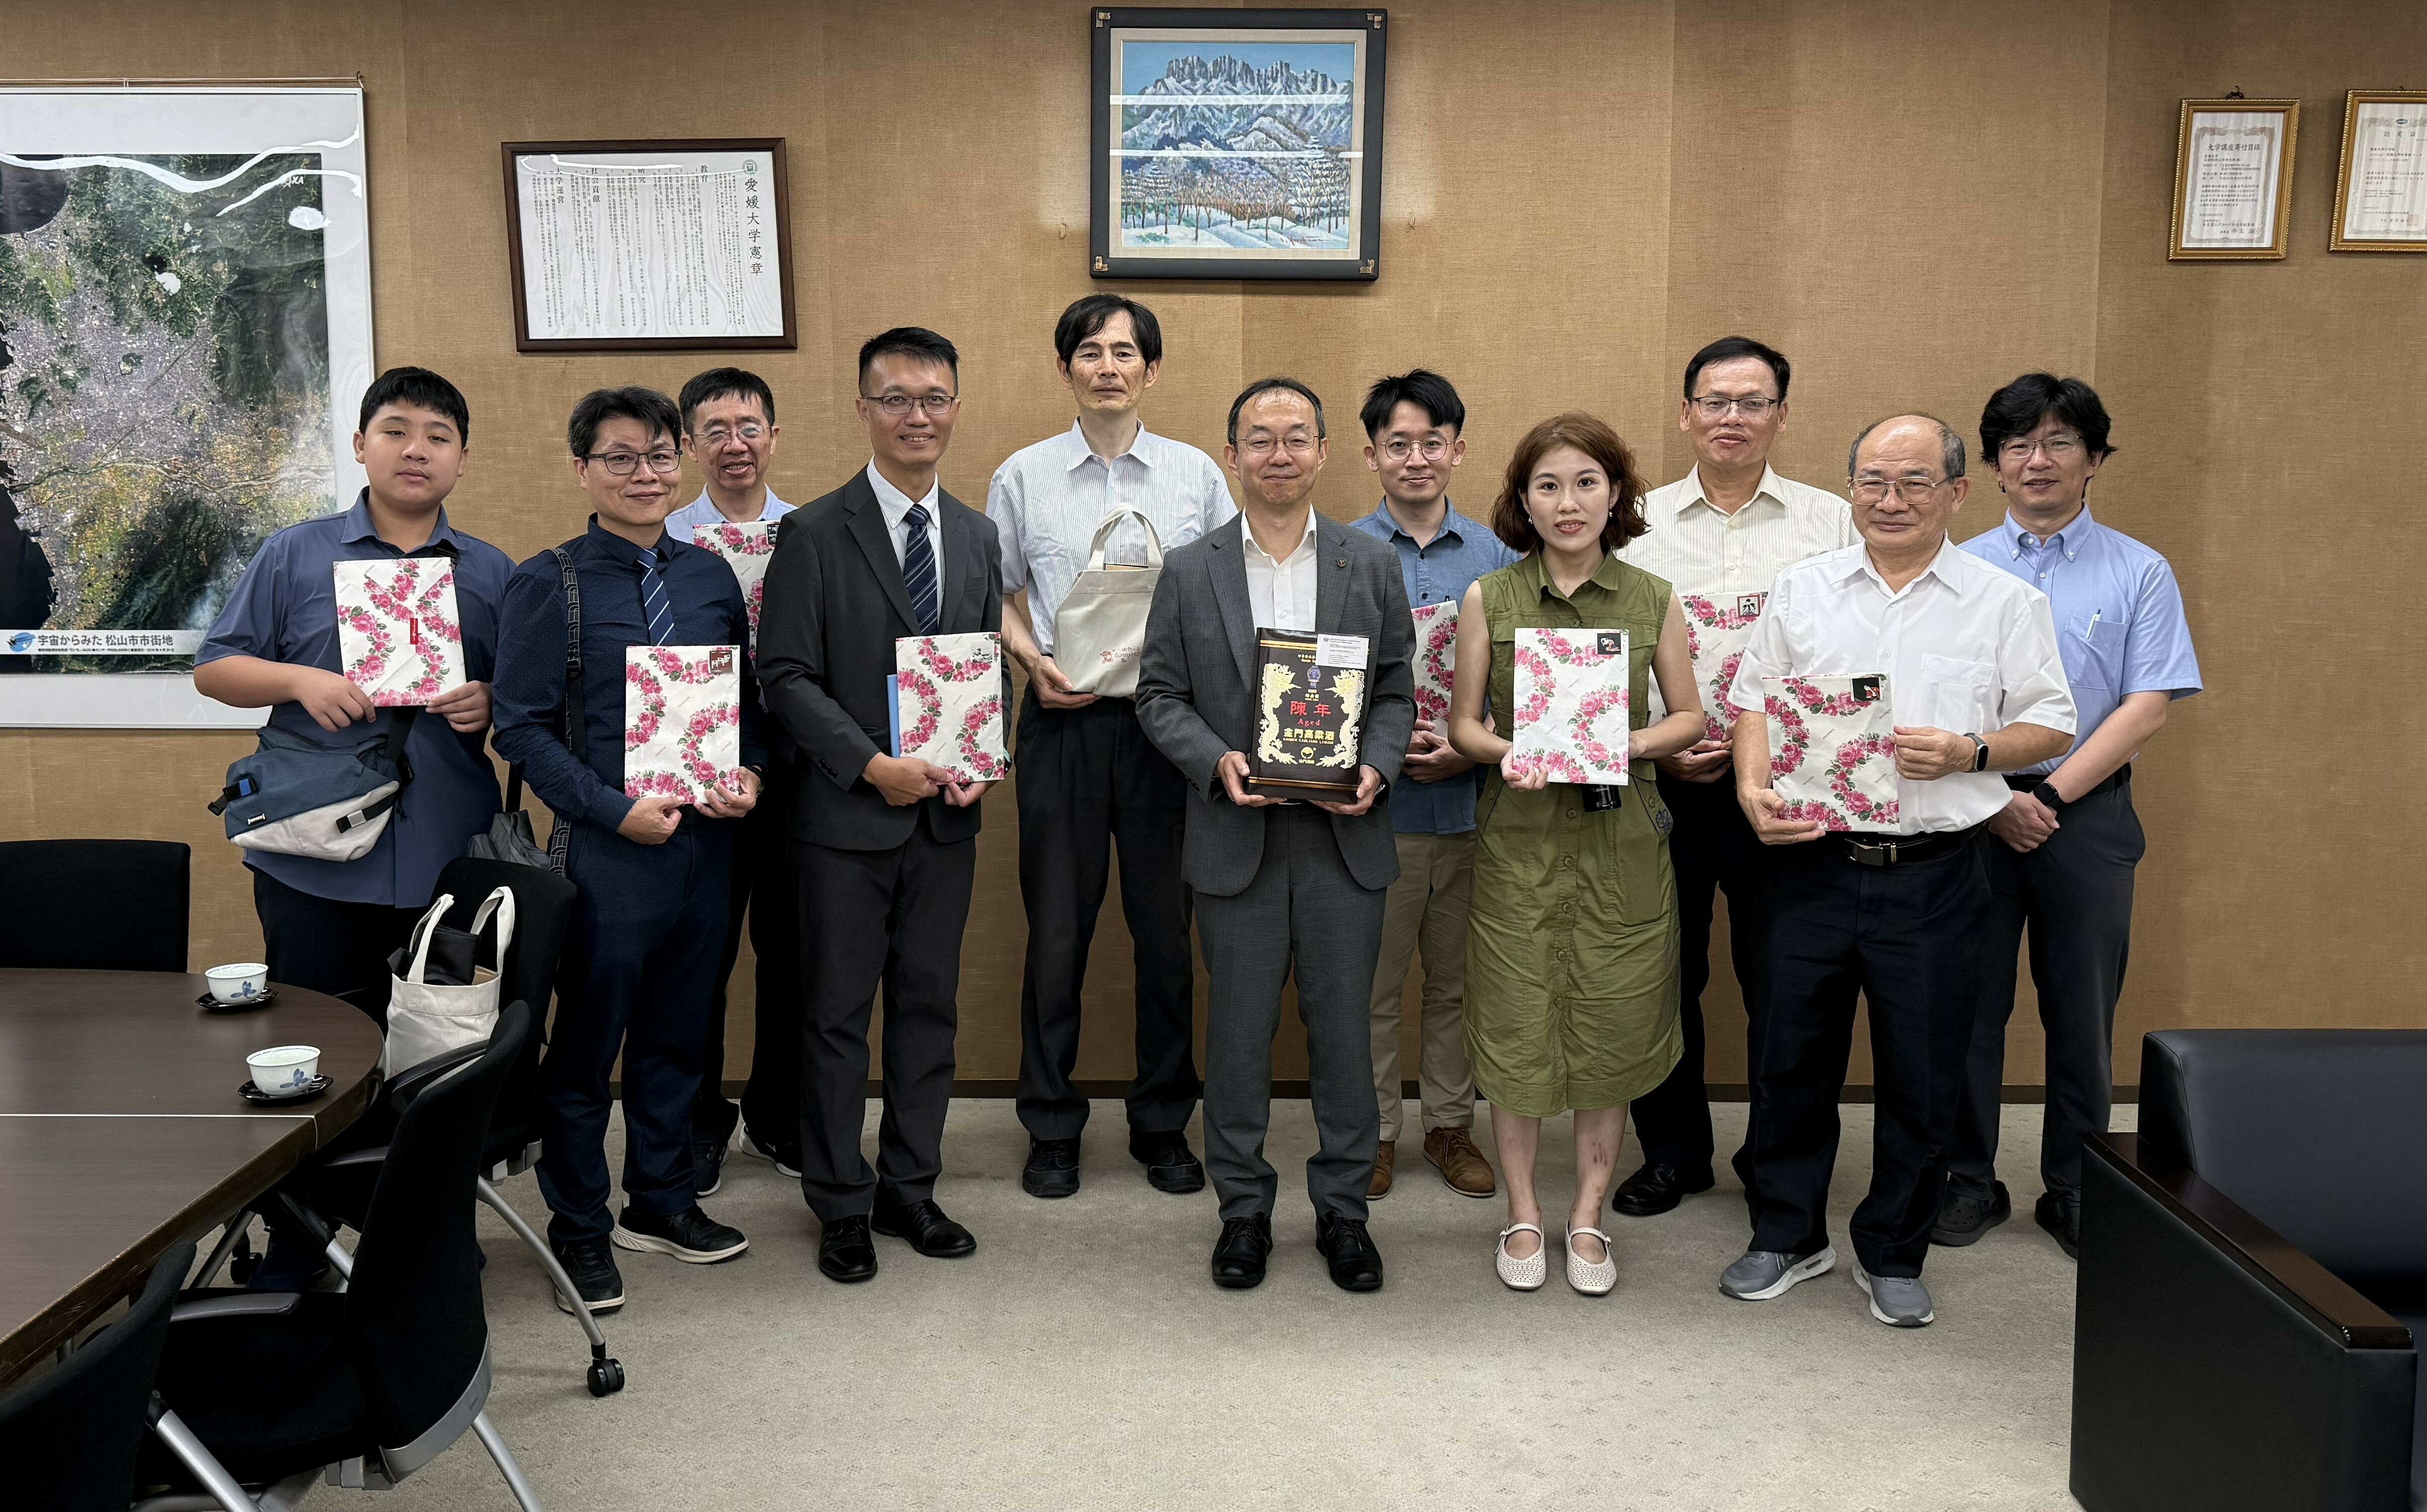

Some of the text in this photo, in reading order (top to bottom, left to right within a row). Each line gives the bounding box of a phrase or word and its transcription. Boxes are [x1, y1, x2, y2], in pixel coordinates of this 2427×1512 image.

[701, 165, 708, 182] 教育
[555, 167, 564, 204] 大学運営
[591, 167, 601, 203] 社会貢献
[745, 178, 763, 275] 愛媛大学憲章
[38, 635, 174, 646] 宇宙からみた 松山市市街地
[1290, 701, 1331, 717] 陳年
[1298, 718, 1320, 726] Aged
[1283, 727, 1334, 741] 金門高粱酒
